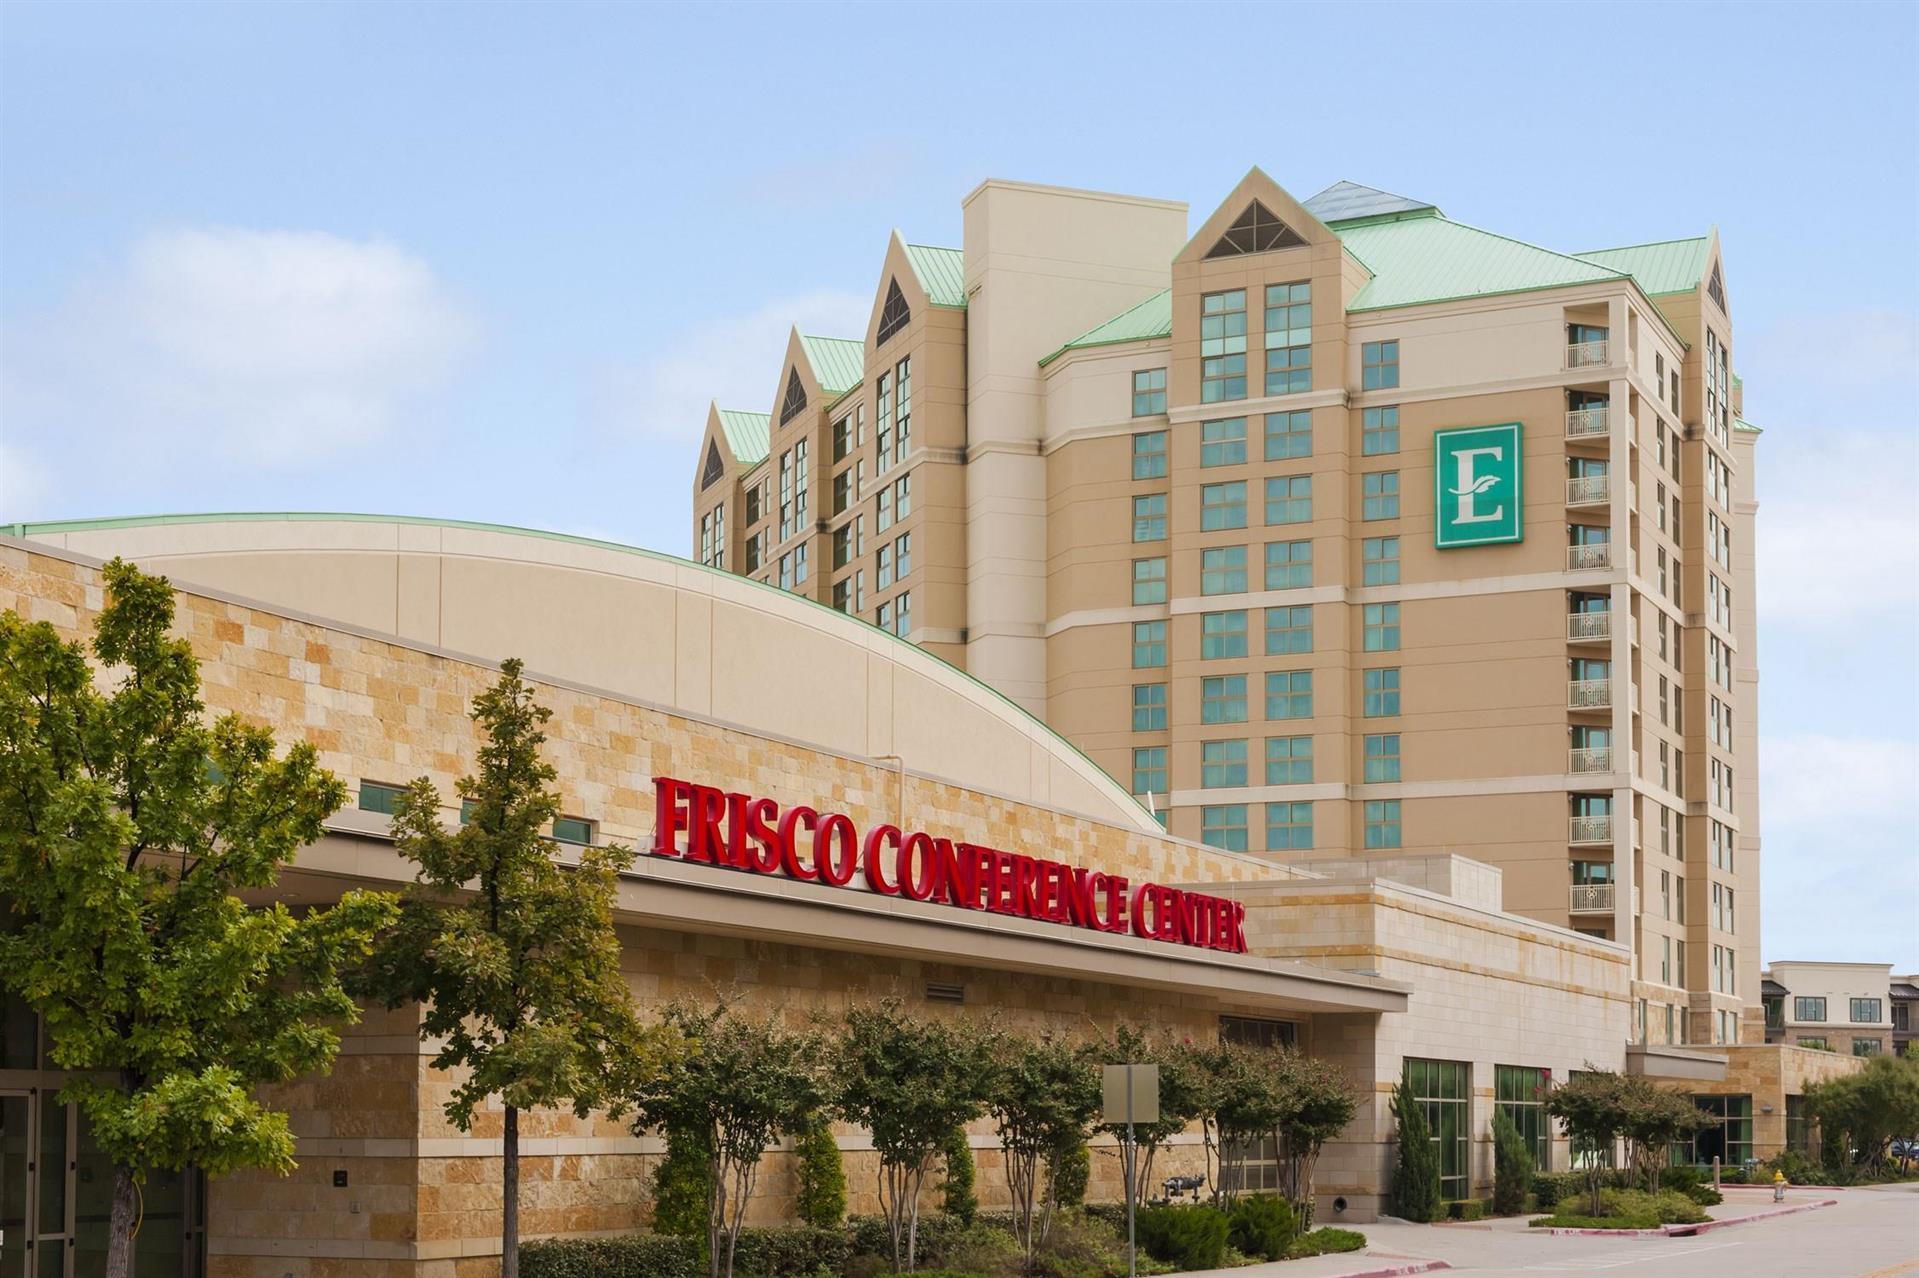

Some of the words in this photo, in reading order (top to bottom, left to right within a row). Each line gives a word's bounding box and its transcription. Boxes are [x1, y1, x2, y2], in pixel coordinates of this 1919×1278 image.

[1449, 446, 1503, 525] E
[651, 776, 858, 887] FRISCO
[863, 823, 1130, 935] CONFERENCE
[1130, 881, 1248, 954] CENTER
